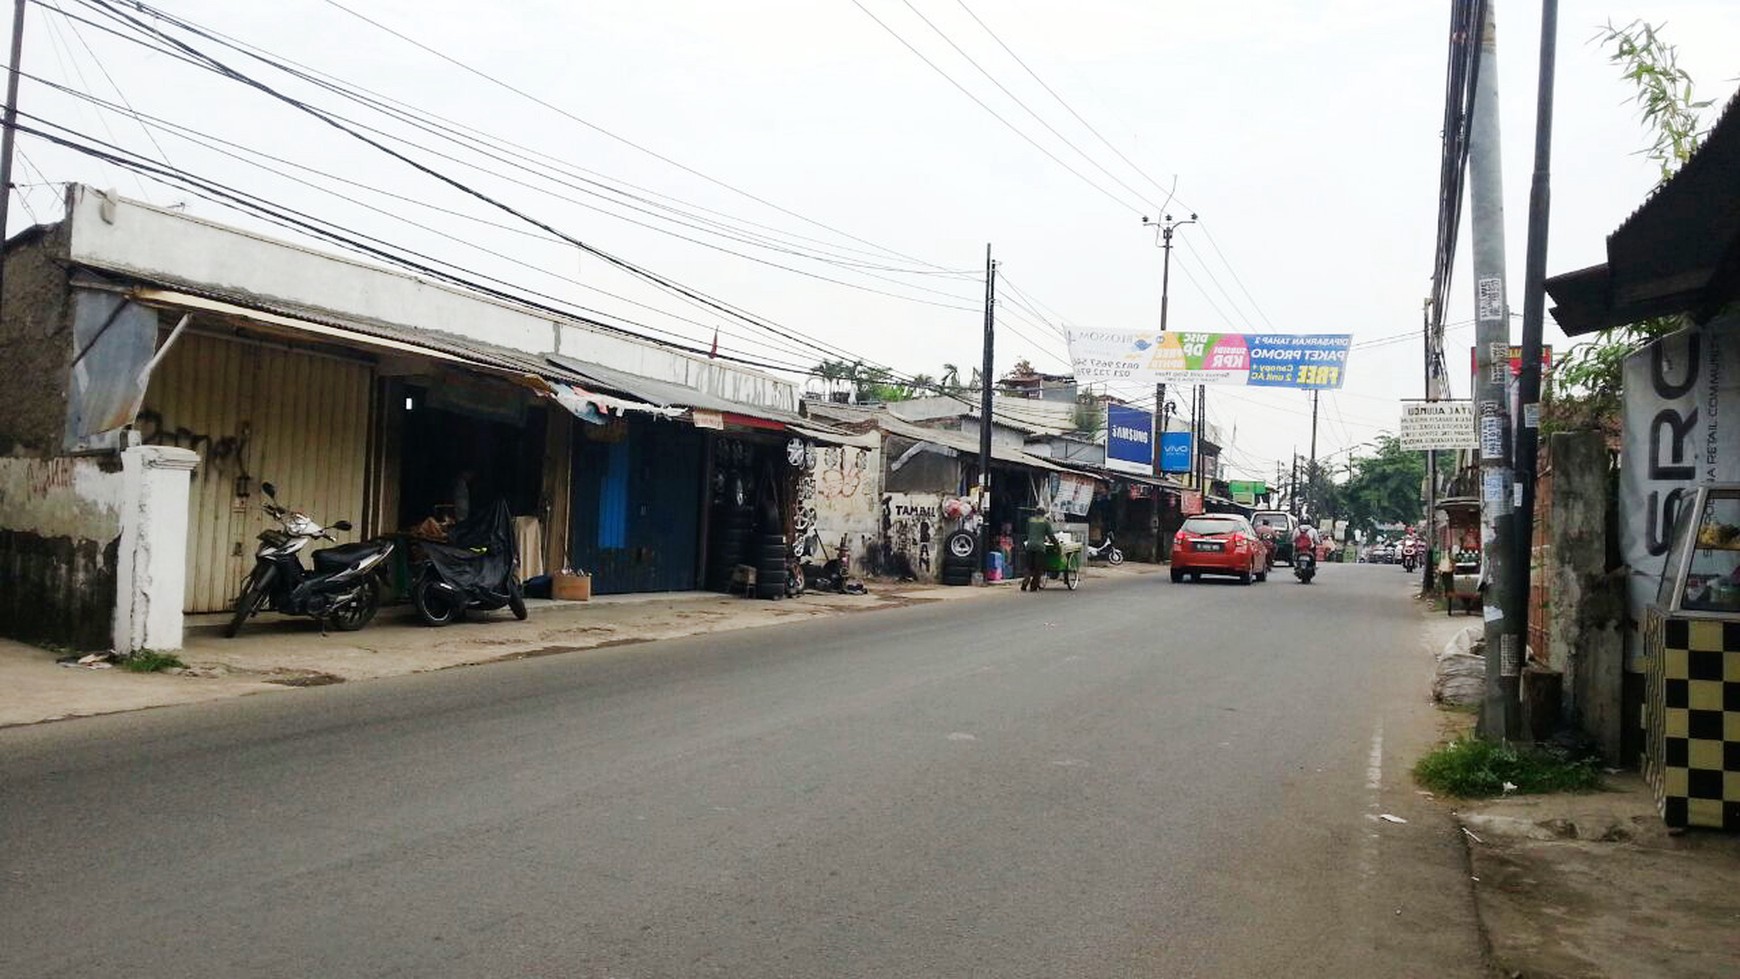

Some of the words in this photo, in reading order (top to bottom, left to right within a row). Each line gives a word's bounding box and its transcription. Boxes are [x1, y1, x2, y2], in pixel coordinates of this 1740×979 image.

[1112, 425, 1148, 443] SAMSUNG
[1645, 331, 1700, 557] SRC
[1706, 421, 1717, 464] RETAIL
